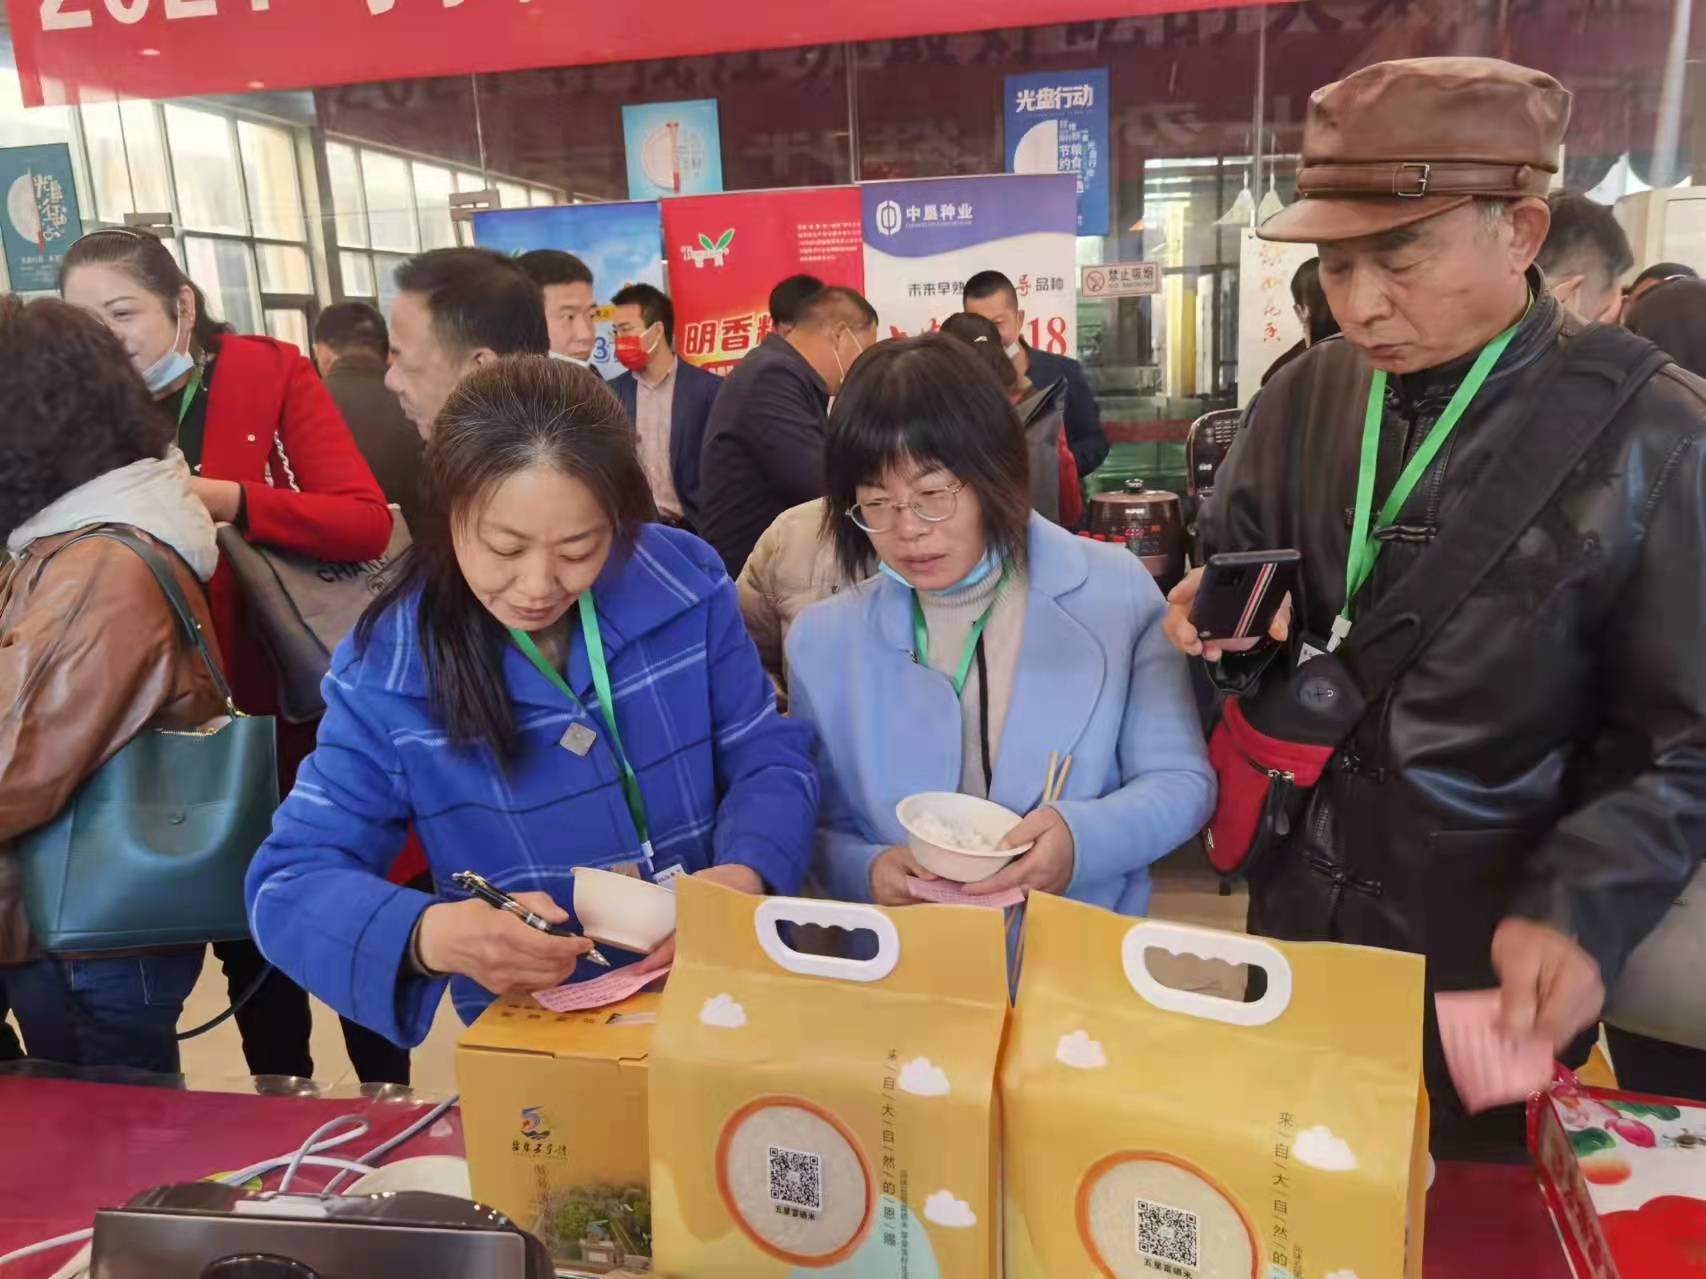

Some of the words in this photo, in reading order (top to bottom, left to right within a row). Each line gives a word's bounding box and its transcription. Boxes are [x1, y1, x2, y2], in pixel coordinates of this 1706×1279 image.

[1015, 83, 1094, 113] 光盘行动
[1107, 265, 1154, 283] 禁止吸烟
[1026, 316, 1067, 356] 18
